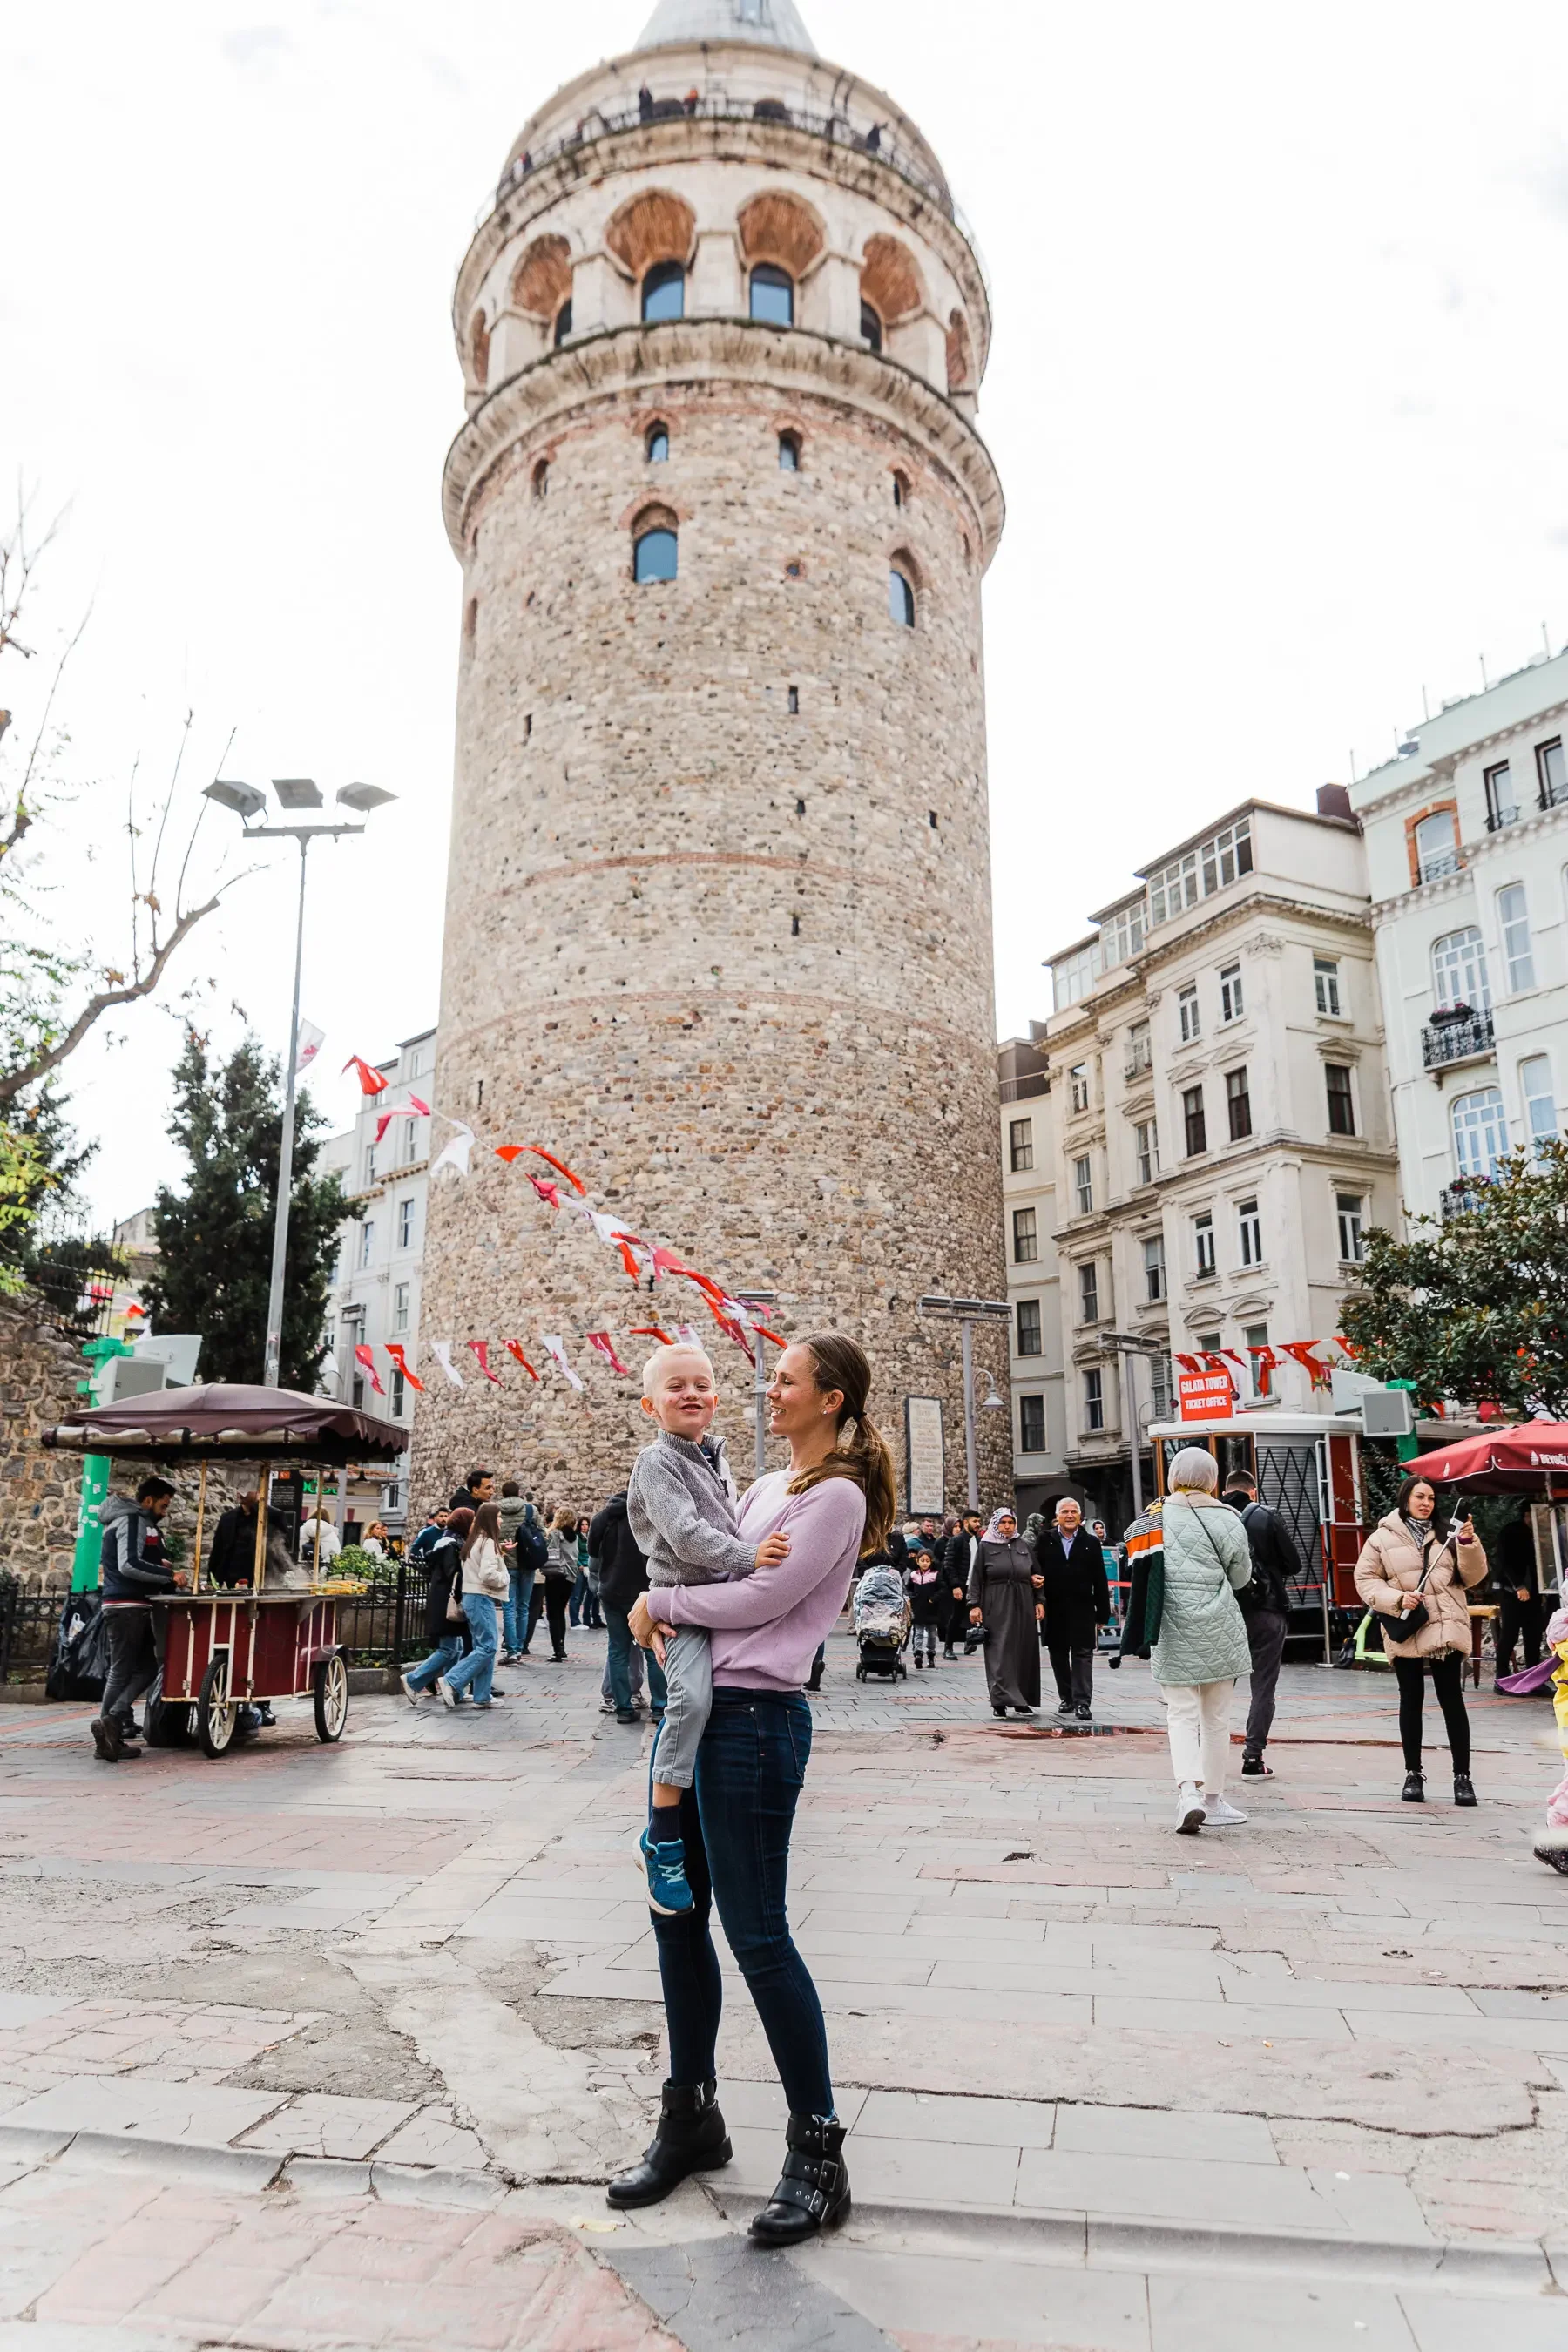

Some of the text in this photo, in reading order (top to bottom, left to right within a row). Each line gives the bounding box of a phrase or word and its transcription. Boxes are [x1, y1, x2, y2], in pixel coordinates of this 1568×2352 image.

[1181, 1375, 1227, 1394] GALATA TOWER
[1185, 1396, 1227, 1409] TICKET OFFICE
[1539, 1453, 1568, 1466] BEYOĞL
